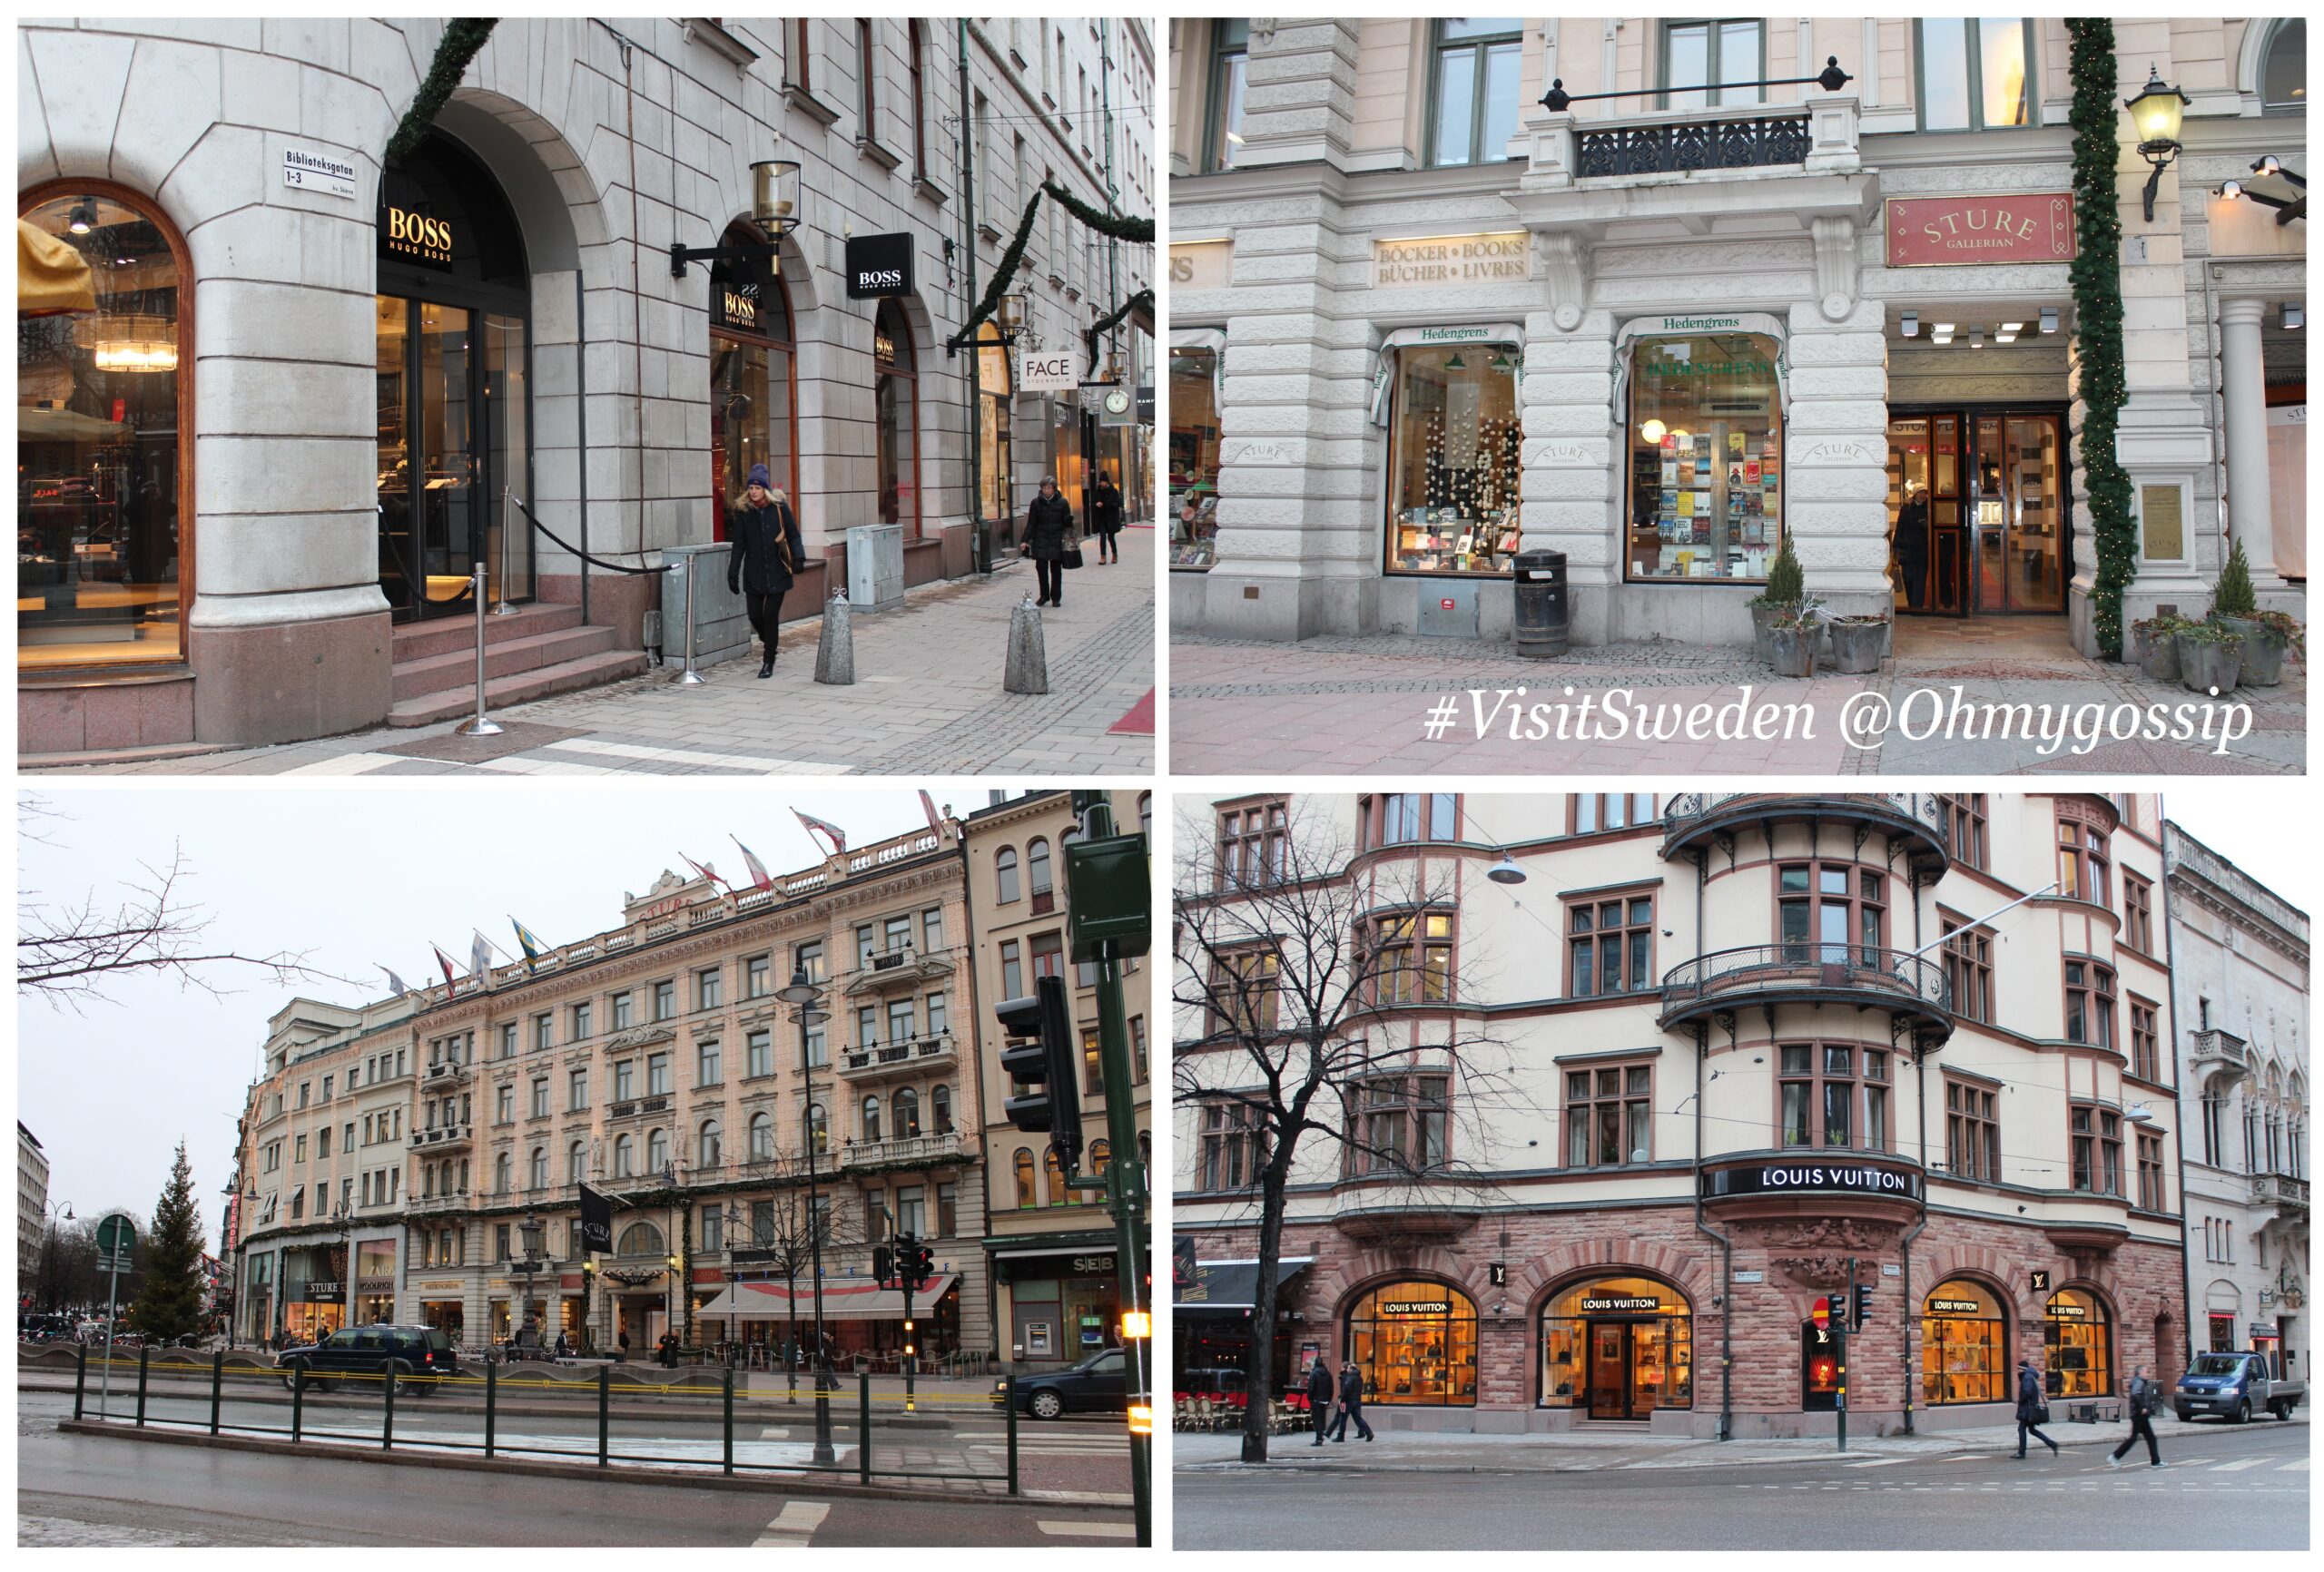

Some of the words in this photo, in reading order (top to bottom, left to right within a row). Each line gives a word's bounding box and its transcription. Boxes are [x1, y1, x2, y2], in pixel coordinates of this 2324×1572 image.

[287, 151, 353, 176] Biblioteksgatan
[389, 207, 451, 251] BOSS
[1925, 209, 2037, 243] STURE
[389, 241, 418, 254] HUGO
[425, 249, 451, 262] BOSS
[1379, 245, 1448, 263] BÖCKER
[1462, 241, 1523, 258] BOOKS
[1946, 239, 2014, 249] GALLERIAN
[859, 270, 901, 285] BOSS
[1378, 265, 1448, 282] BÜCHER
[1463, 260, 1524, 278] LIVRES
[725, 291, 754, 319] BOSS
[1663, 318, 1739, 329] Hedengrens
[1422, 328, 1489, 340] Hedengrens
[876, 337, 893, 356] BOSS
[1027, 359, 1069, 377] FACE
[1814, 443, 1862, 459] STURE
[1762, 1169, 1824, 1186] LOUIS
[1829, 1169, 1905, 1190] VUITTON
[1073, 1256, 1115, 1272] SEB
[310, 1282, 338, 1292] STURE
[1385, 1303, 1410, 1312] LOUIS
[1412, 1303, 1447, 1312] VUITTON
[1583, 1300, 1610, 1309] LOUIS
[1613, 1299, 1656, 1308] VUITTON
[1935, 1301, 1953, 1310] LOUIS
[1953, 1302, 1977, 1311] VUITTON
[2065, 1307, 2084, 1315] VUITTON
